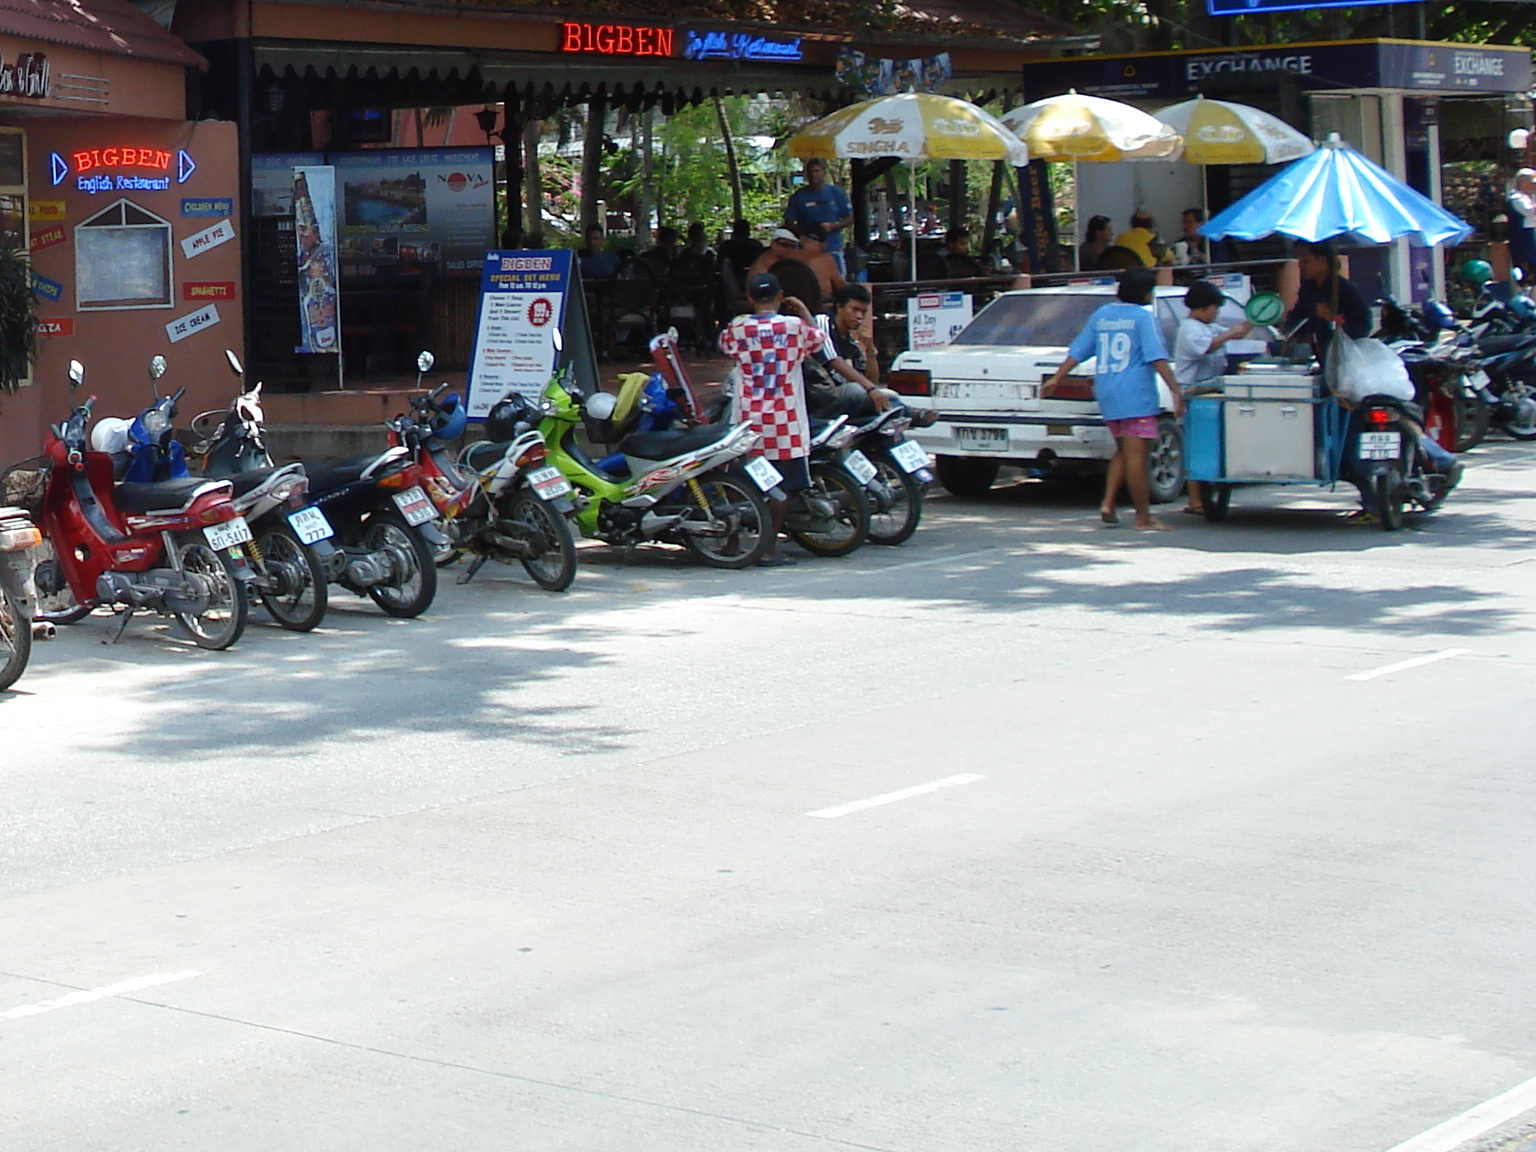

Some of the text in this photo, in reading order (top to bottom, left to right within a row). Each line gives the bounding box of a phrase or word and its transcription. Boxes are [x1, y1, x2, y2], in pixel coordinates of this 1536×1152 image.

[563, 22, 674, 56] BIGBEN
[1453, 57, 1504, 76] EXCHANGE
[846, 140, 910, 153] SINGHA
[74, 147, 171, 171] BIGBEN
[77, 175, 171, 194] English Restaurant
[41, 231, 62, 245] STEAK
[192, 235, 210, 249] APPLE
[501, 257, 552, 271] BIGBEN
[191, 286, 227, 296] SPAGHETTI
[175, 312, 211, 335] ICE CREAM
[1097, 331, 1131, 375] 19
[306, 528, 326, 542] 777
